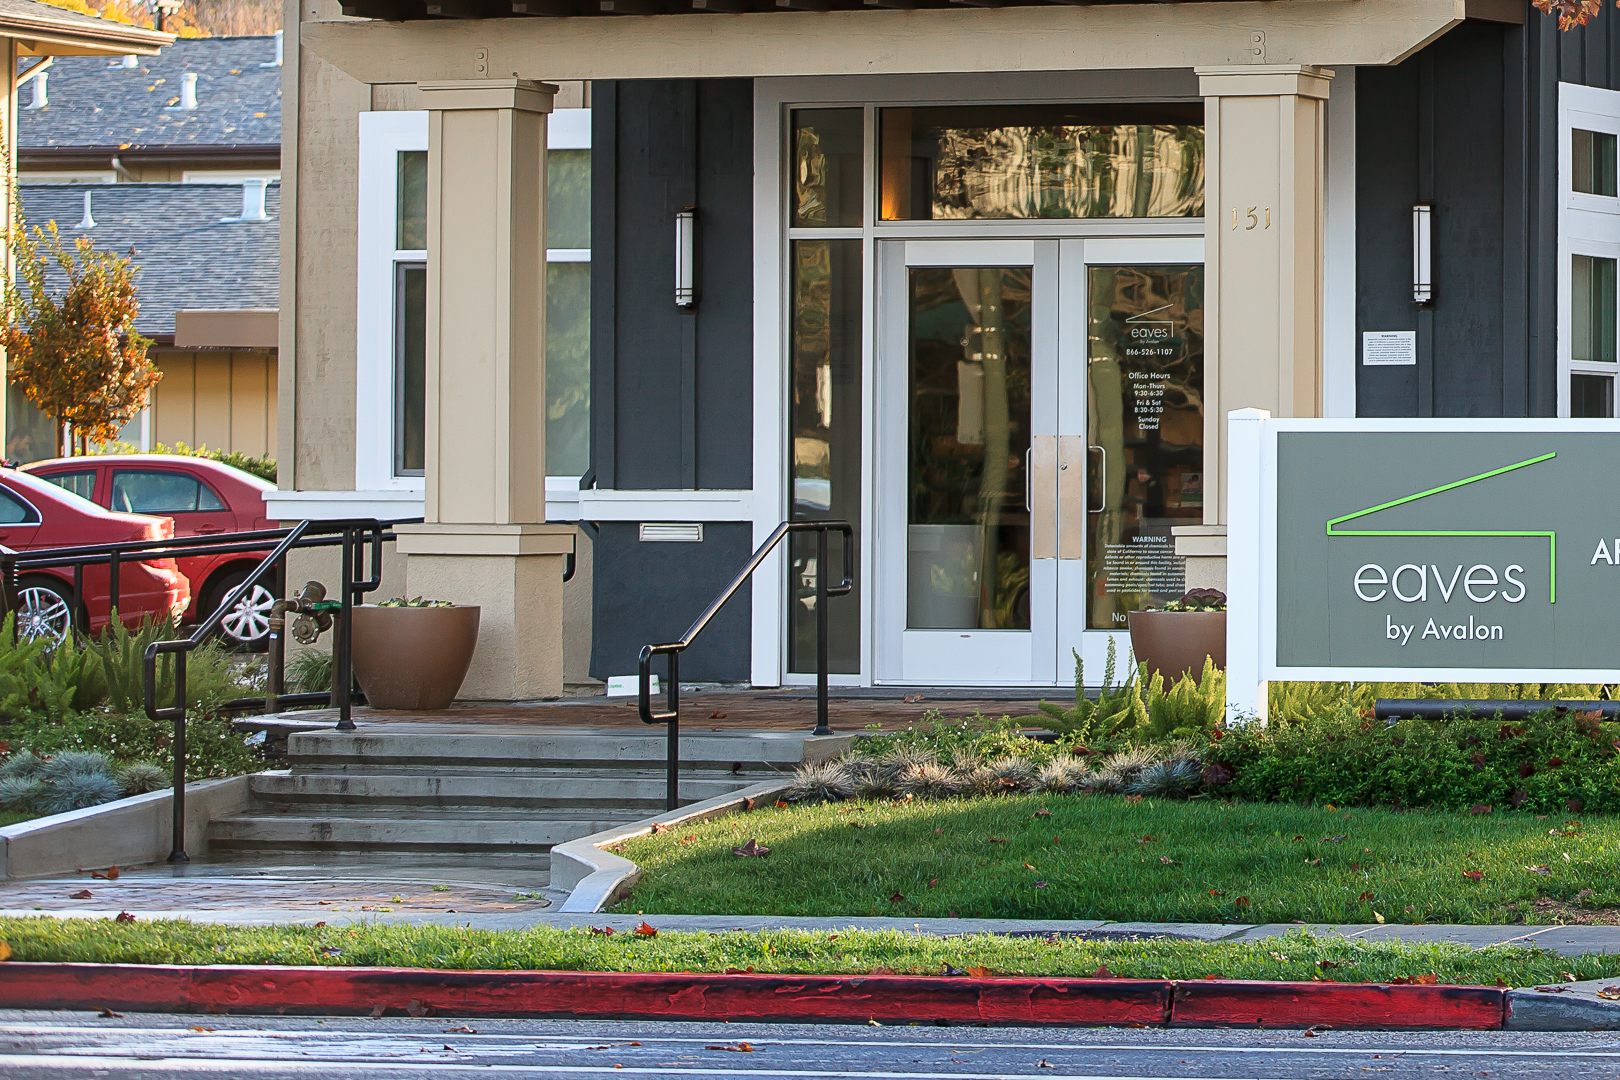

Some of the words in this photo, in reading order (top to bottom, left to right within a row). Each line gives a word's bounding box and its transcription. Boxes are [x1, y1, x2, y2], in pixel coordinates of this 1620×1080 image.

[1232, 206, 1270, 230] 151
[1131, 328, 1168, 338] eaves
[1353, 563, 1527, 603] eaves
[1112, 612, 1126, 622] No
[1386, 614, 1415, 646] by
[1421, 615, 1504, 640] Avalon
